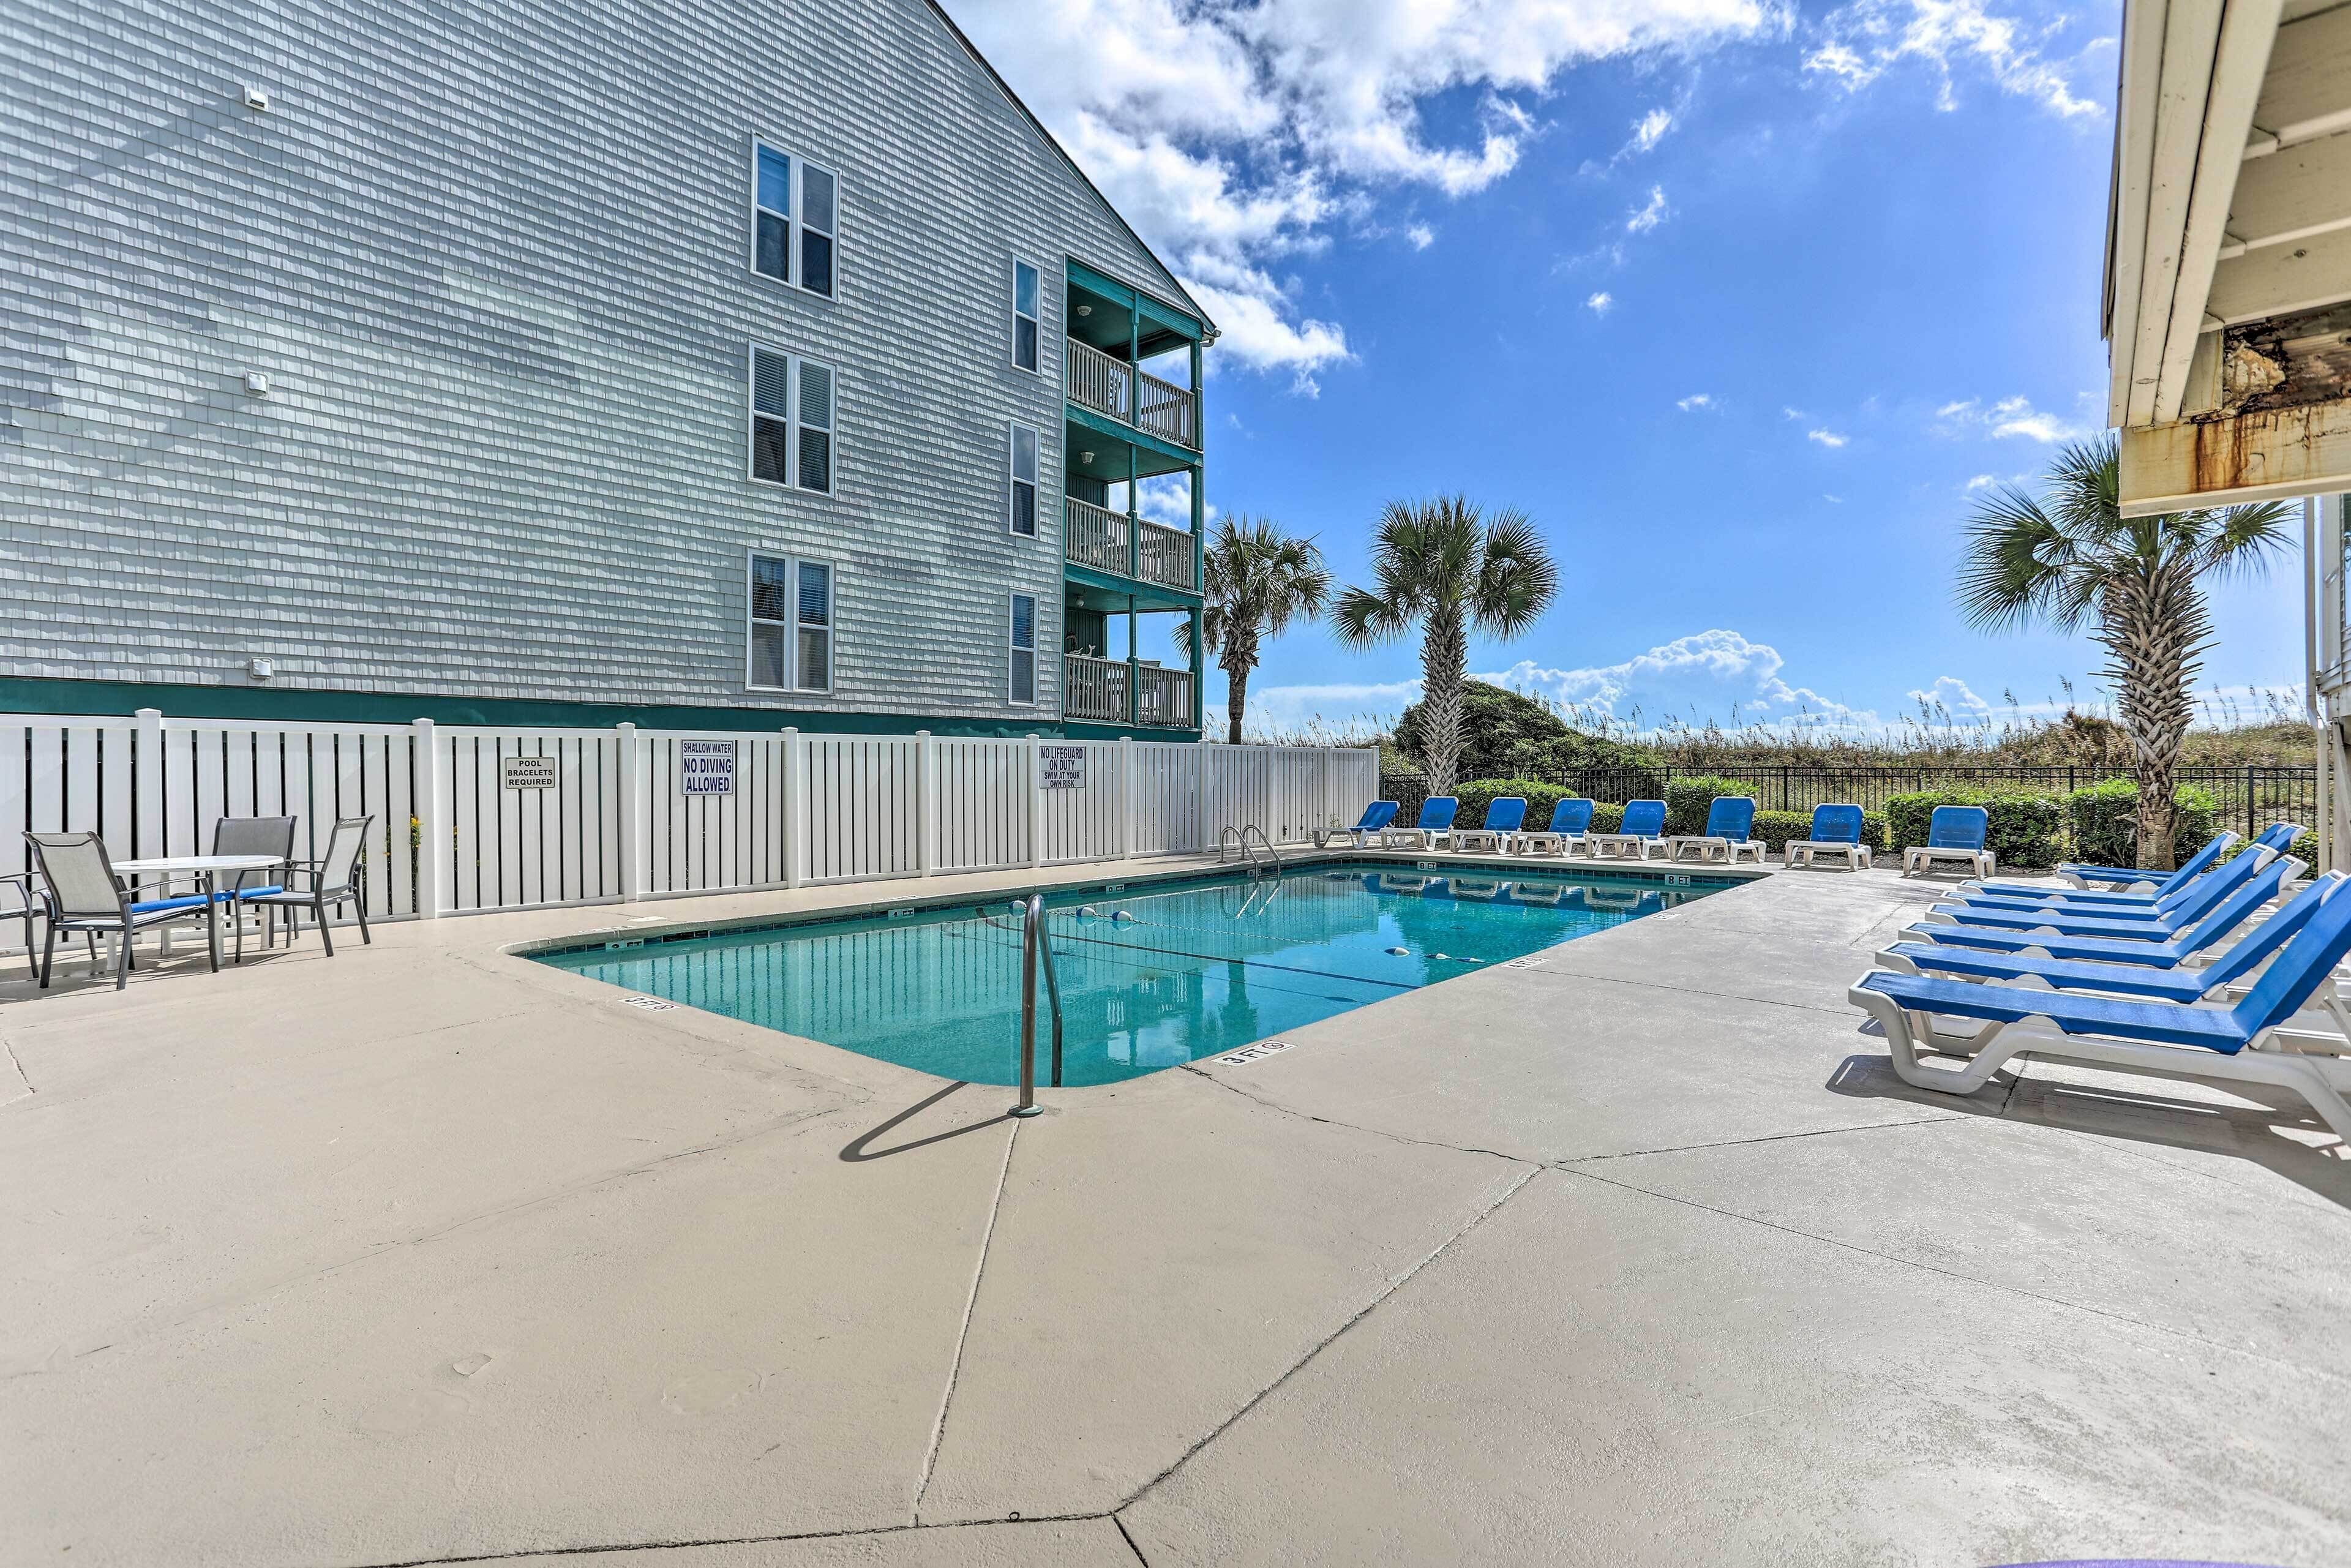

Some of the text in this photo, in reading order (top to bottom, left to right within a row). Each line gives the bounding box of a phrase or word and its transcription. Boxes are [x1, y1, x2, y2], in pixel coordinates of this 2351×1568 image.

[683, 743, 732, 754] SHALLOW WATER
[1041, 748, 1083, 759] NO LIFEGUARD
[684, 758, 732, 773] NO DIVING
[1049, 759, 1075, 770] ON DUTY
[1237, 1048, 1269, 1059] FT
